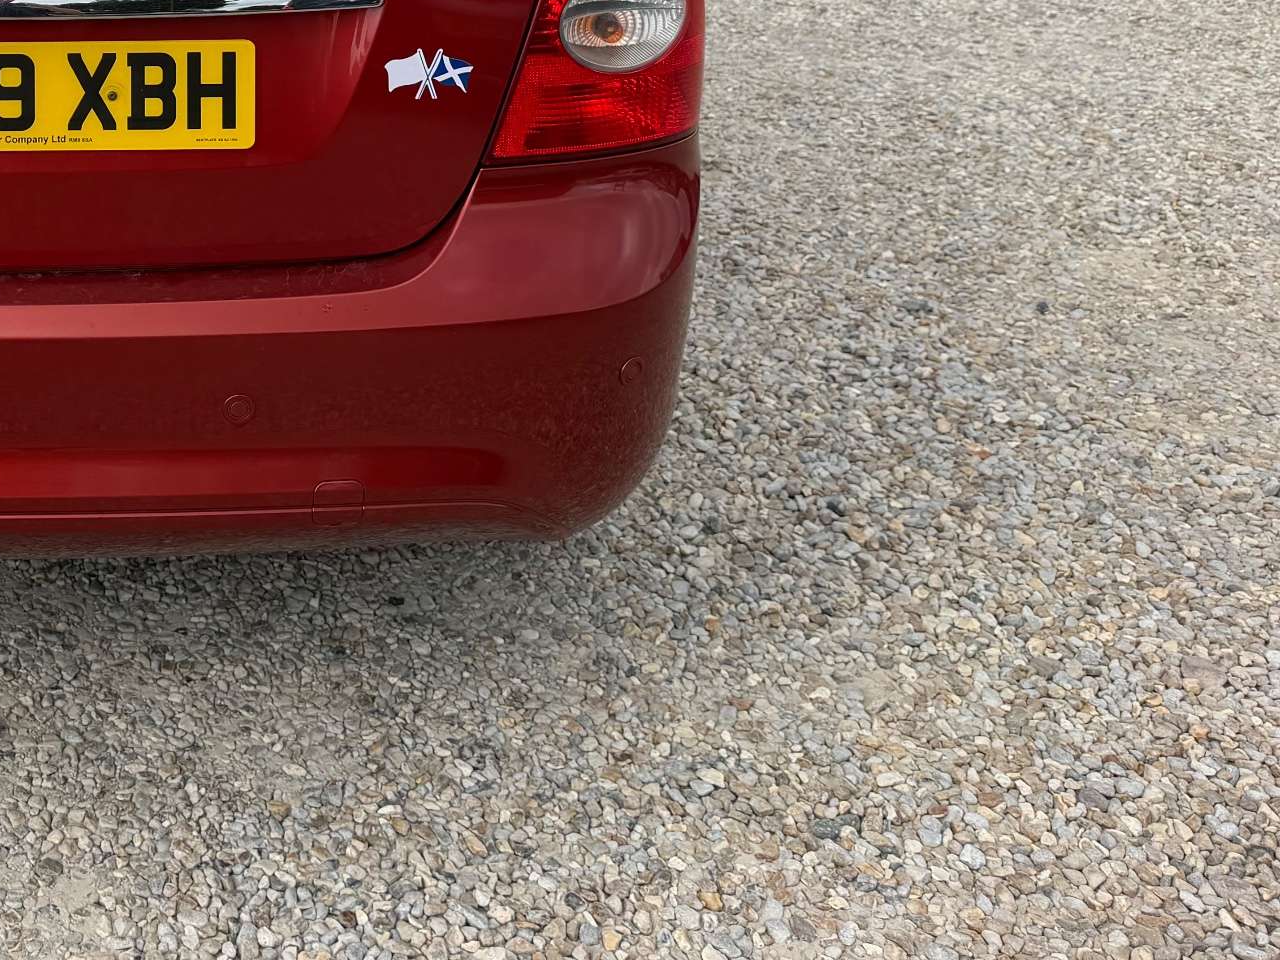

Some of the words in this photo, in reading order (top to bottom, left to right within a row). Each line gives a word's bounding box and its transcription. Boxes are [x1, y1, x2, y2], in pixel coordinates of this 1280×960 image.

[66, 51, 237, 131] XBH
[5, 134, 49, 145] Company
[51, 134, 66, 144] Ltd
